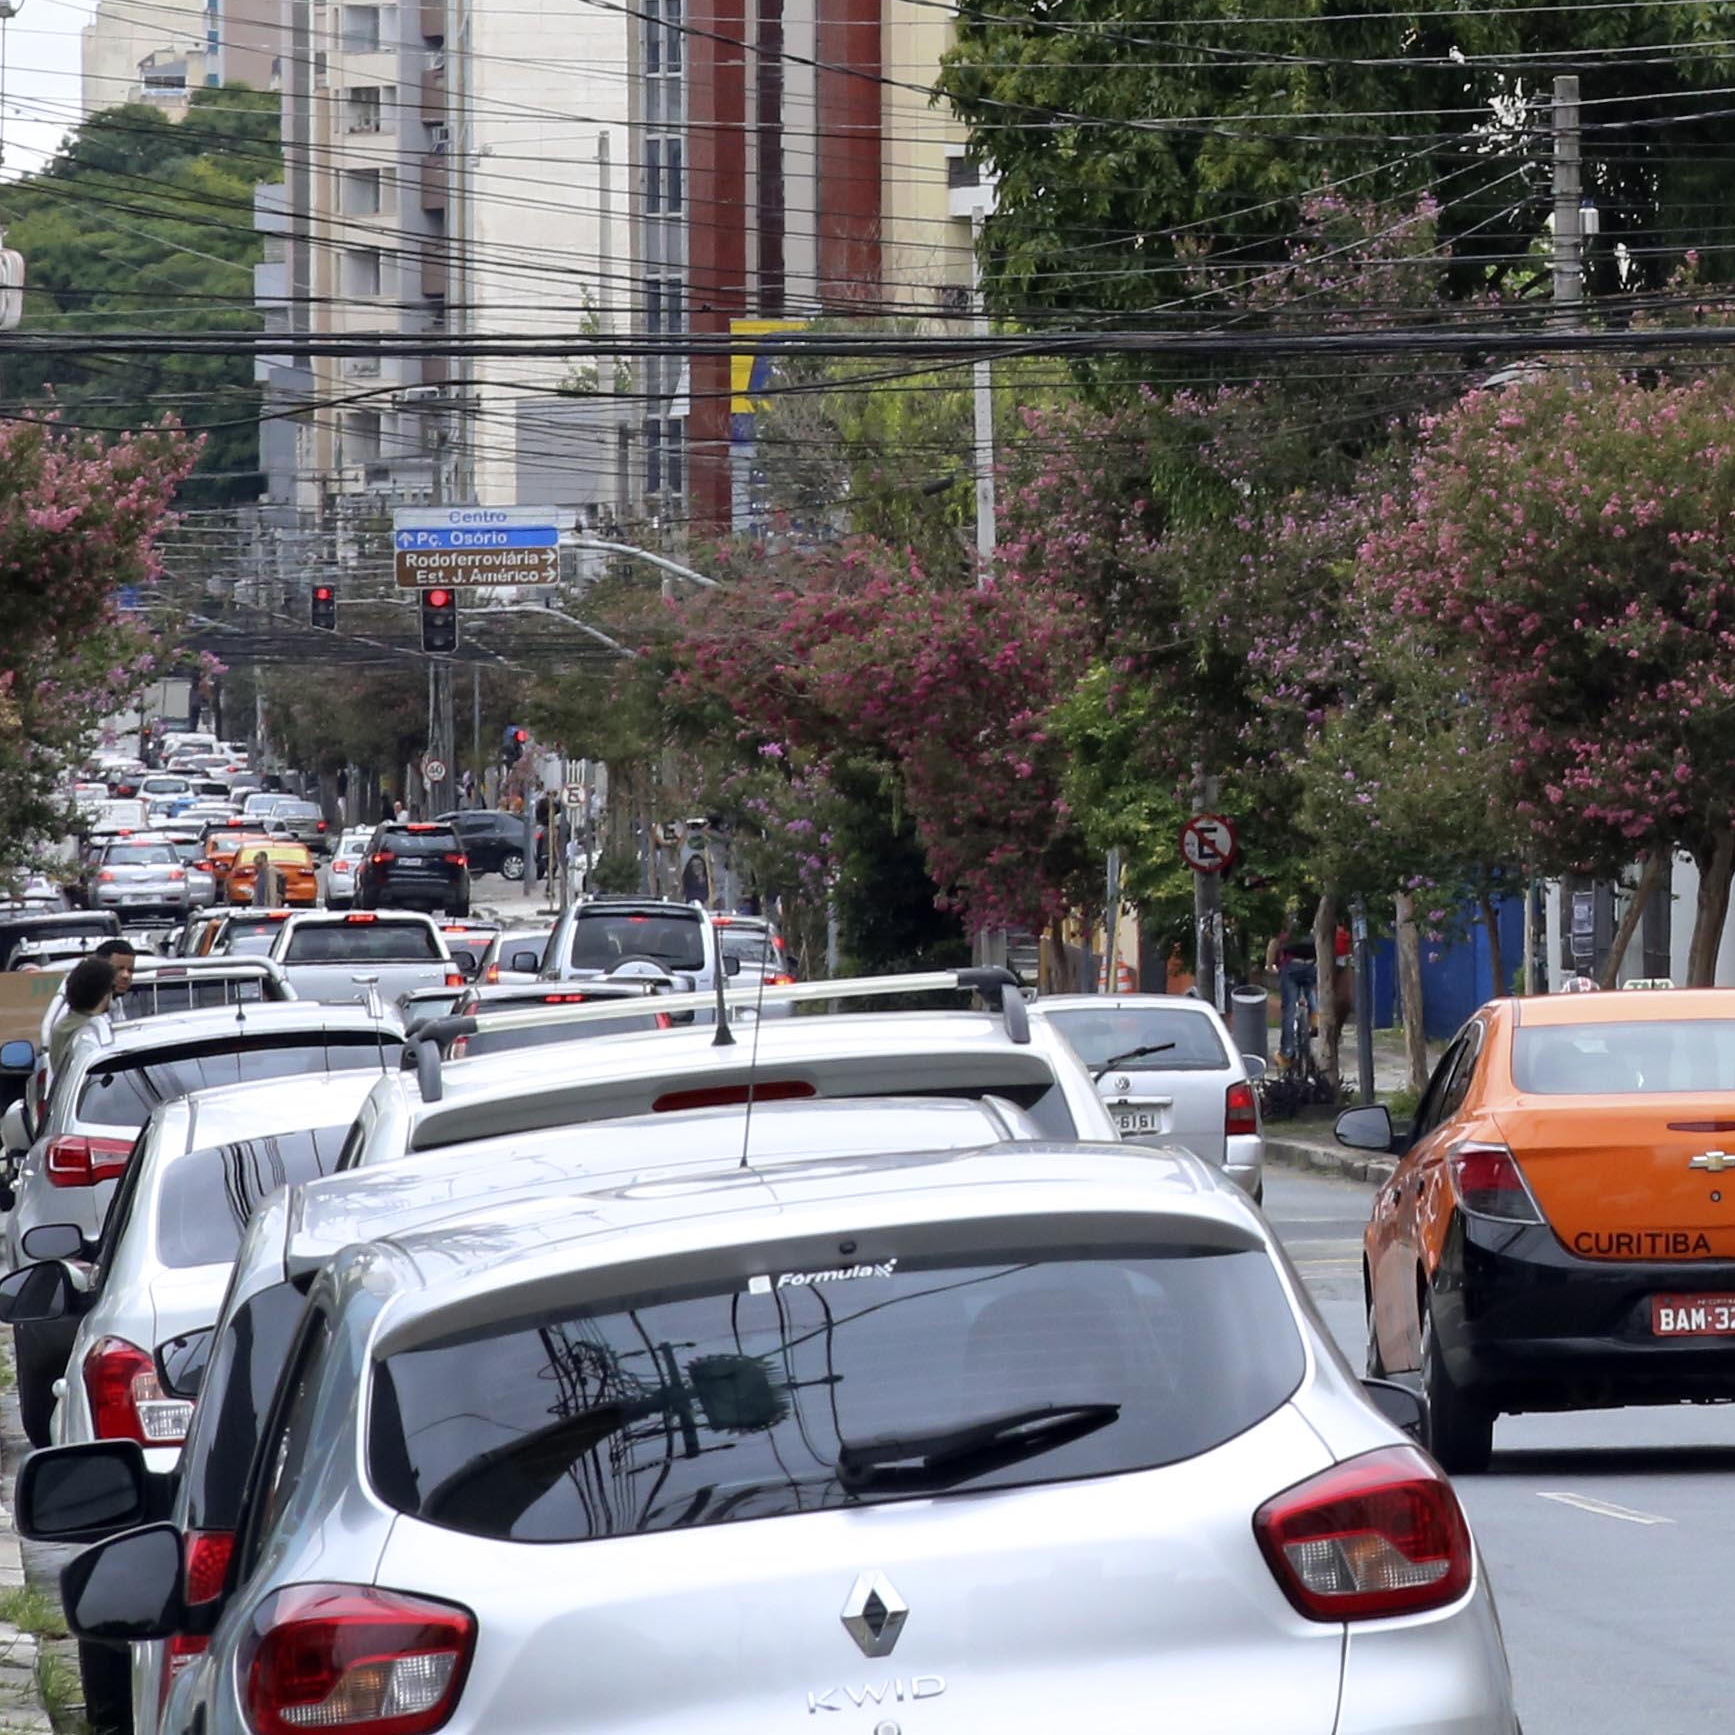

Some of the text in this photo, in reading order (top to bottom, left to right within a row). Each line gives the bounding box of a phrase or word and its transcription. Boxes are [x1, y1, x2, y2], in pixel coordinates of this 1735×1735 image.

[449, 510, 508, 524] Centro
[417, 531, 507, 547] Pç. Osório
[405, 550, 539, 567] Rodoferroviária
[416, 568, 539, 583] Est. J. Américo
[428, 764, 443, 775] 40
[1574, 1232, 1712, 1255] CURITIBA
[776, 1264, 873, 1289] Formula
[807, 1674, 947, 1715] KWID
